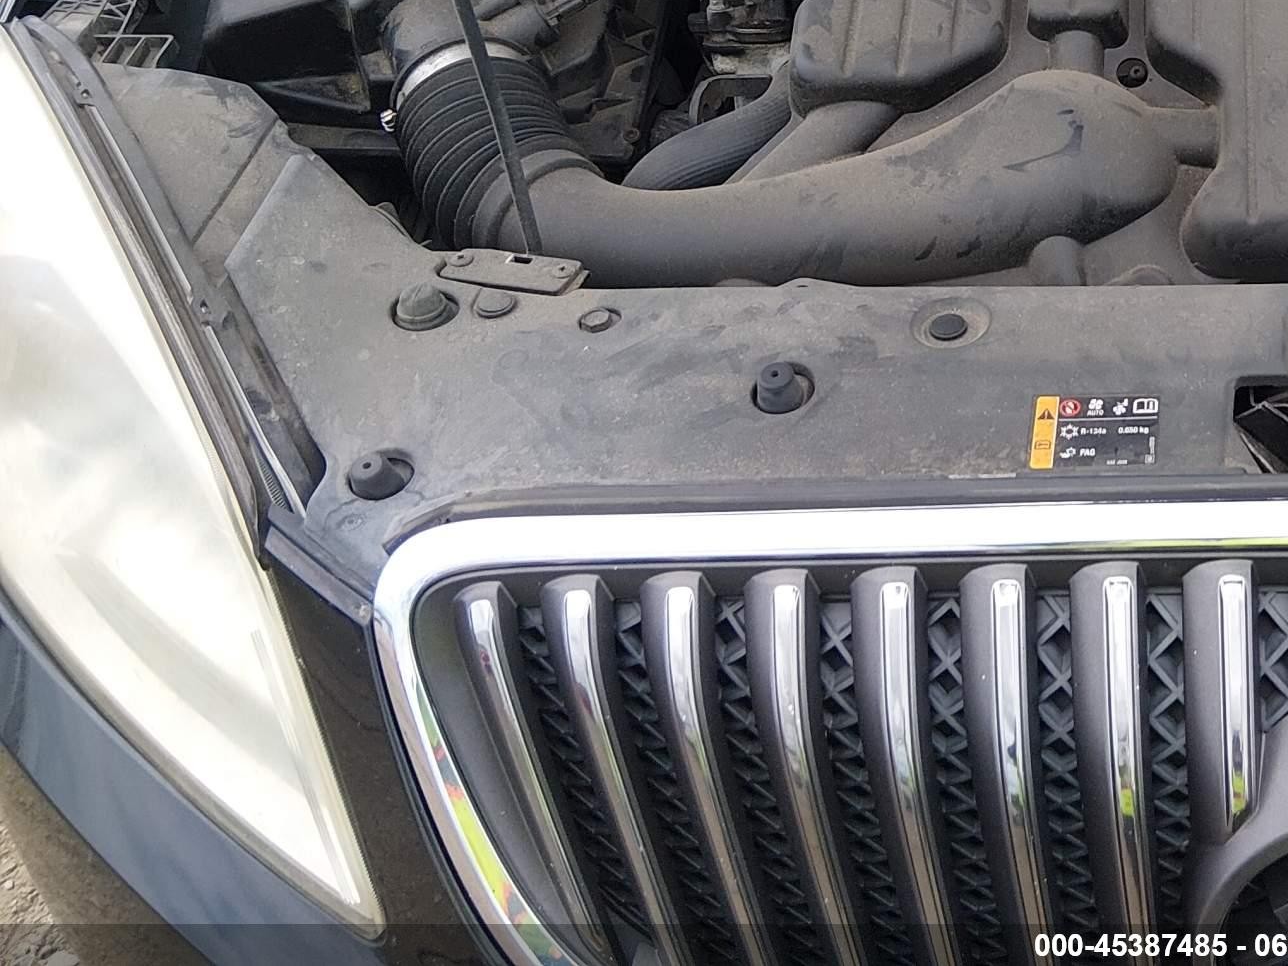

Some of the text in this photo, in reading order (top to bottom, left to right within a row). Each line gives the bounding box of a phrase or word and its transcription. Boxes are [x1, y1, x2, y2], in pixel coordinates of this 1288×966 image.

[1087, 409, 1104, 417] AUTO
[1080, 427, 1107, 435] R-134a
[1139, 426, 1150, 435] kg
